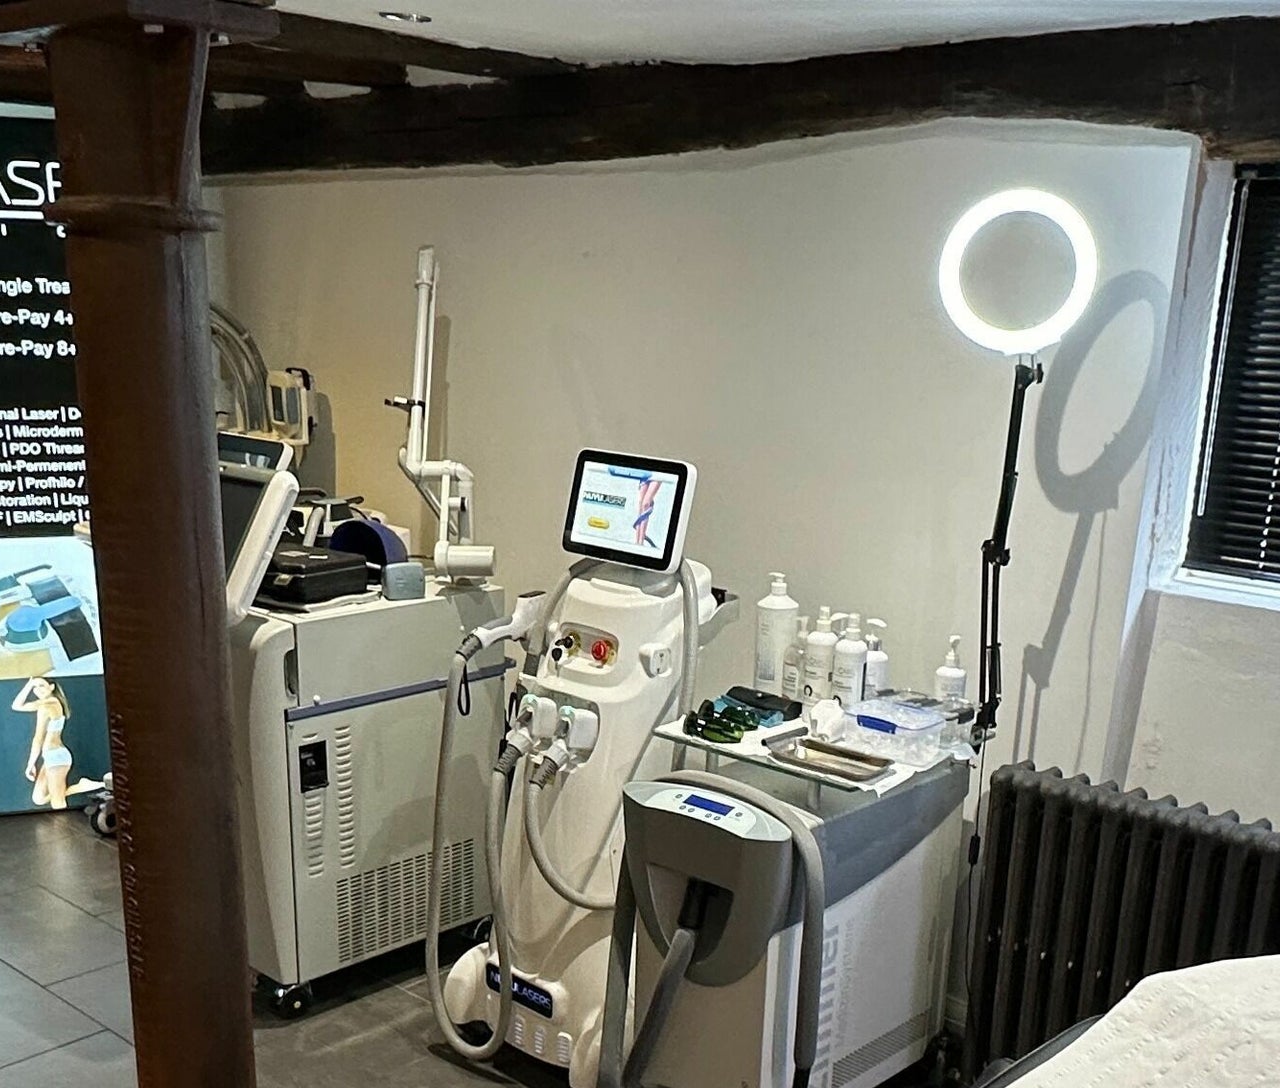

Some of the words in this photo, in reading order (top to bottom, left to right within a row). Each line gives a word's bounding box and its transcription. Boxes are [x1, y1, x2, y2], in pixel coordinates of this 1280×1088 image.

[21, 407, 59, 421] Laser
[9, 442, 41, 455] PDO
[13, 510, 77, 524] EMSculpt
